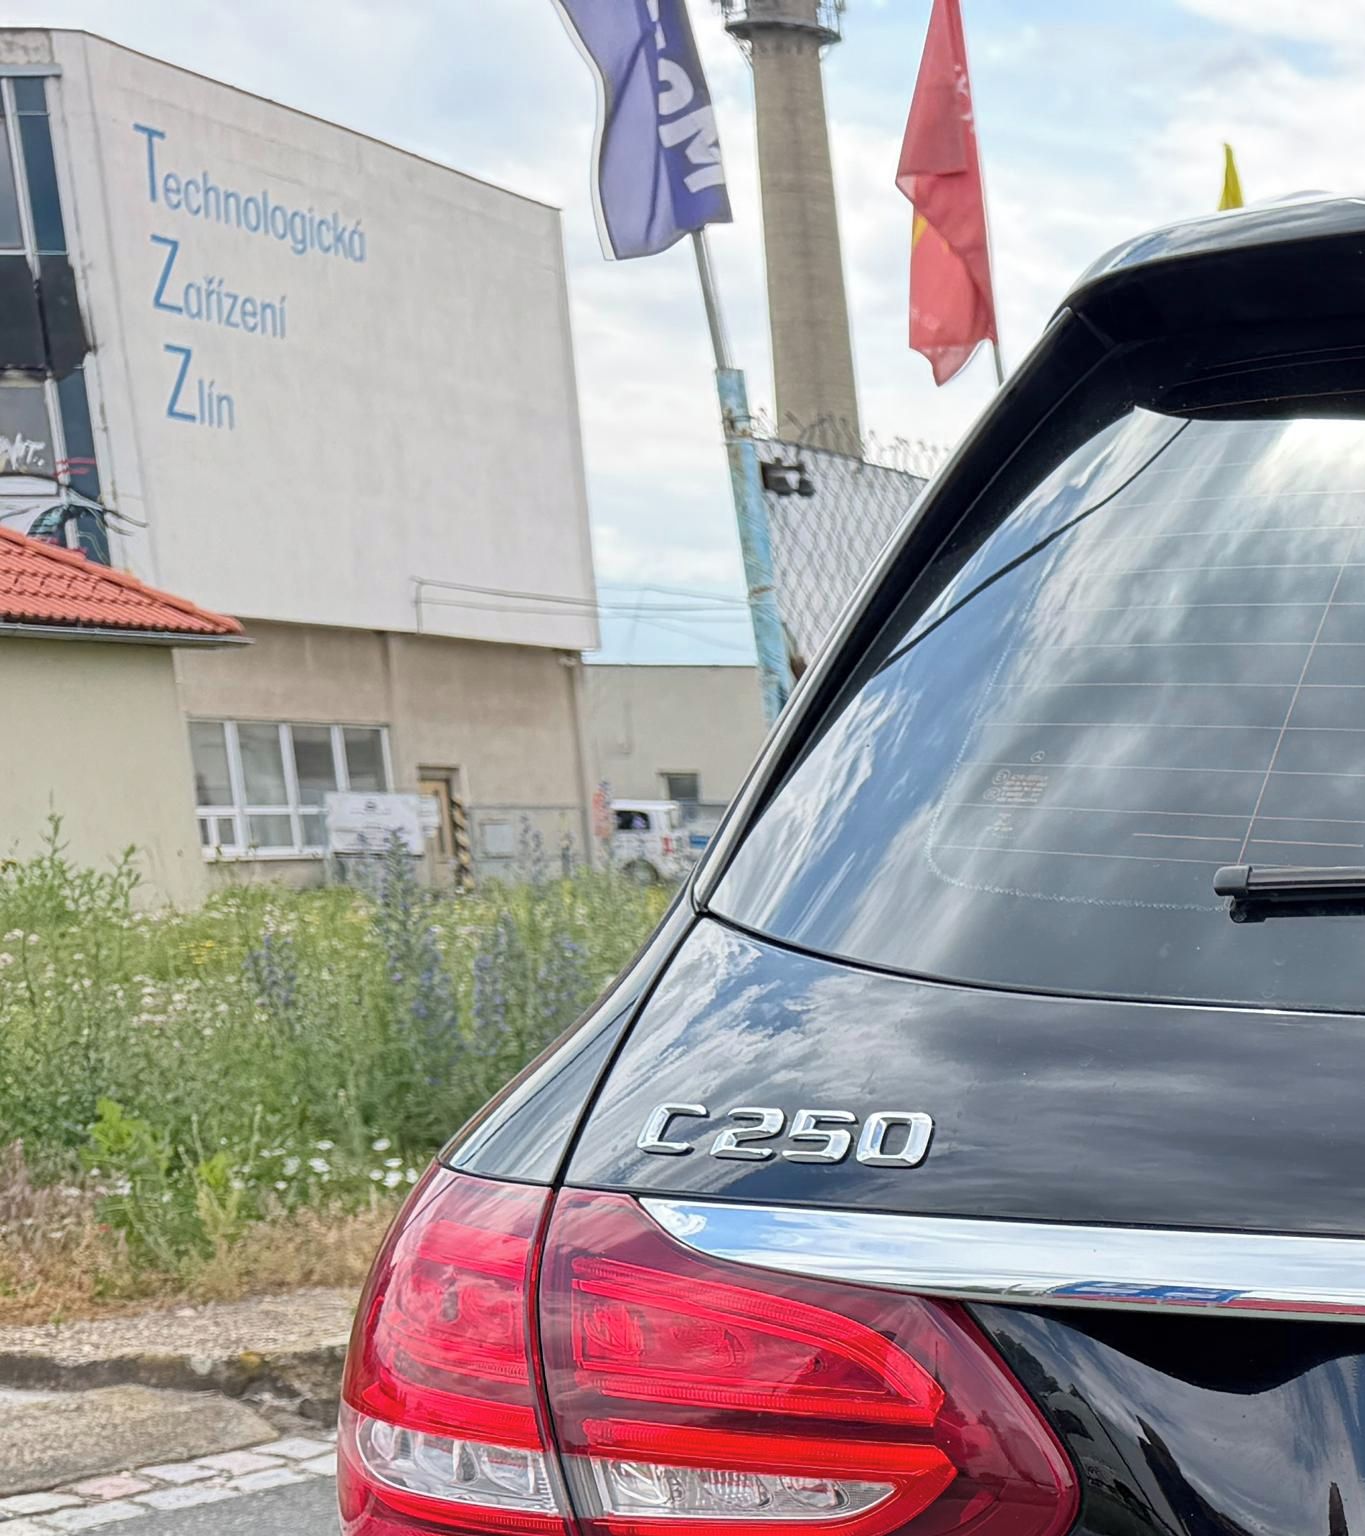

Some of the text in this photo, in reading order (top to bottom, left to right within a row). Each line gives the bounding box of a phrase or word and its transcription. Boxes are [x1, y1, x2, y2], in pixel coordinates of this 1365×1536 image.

[132, 121, 367, 263] Technologická
[150, 233, 288, 340] Zařízení
[163, 343, 236, 431] Zlín
